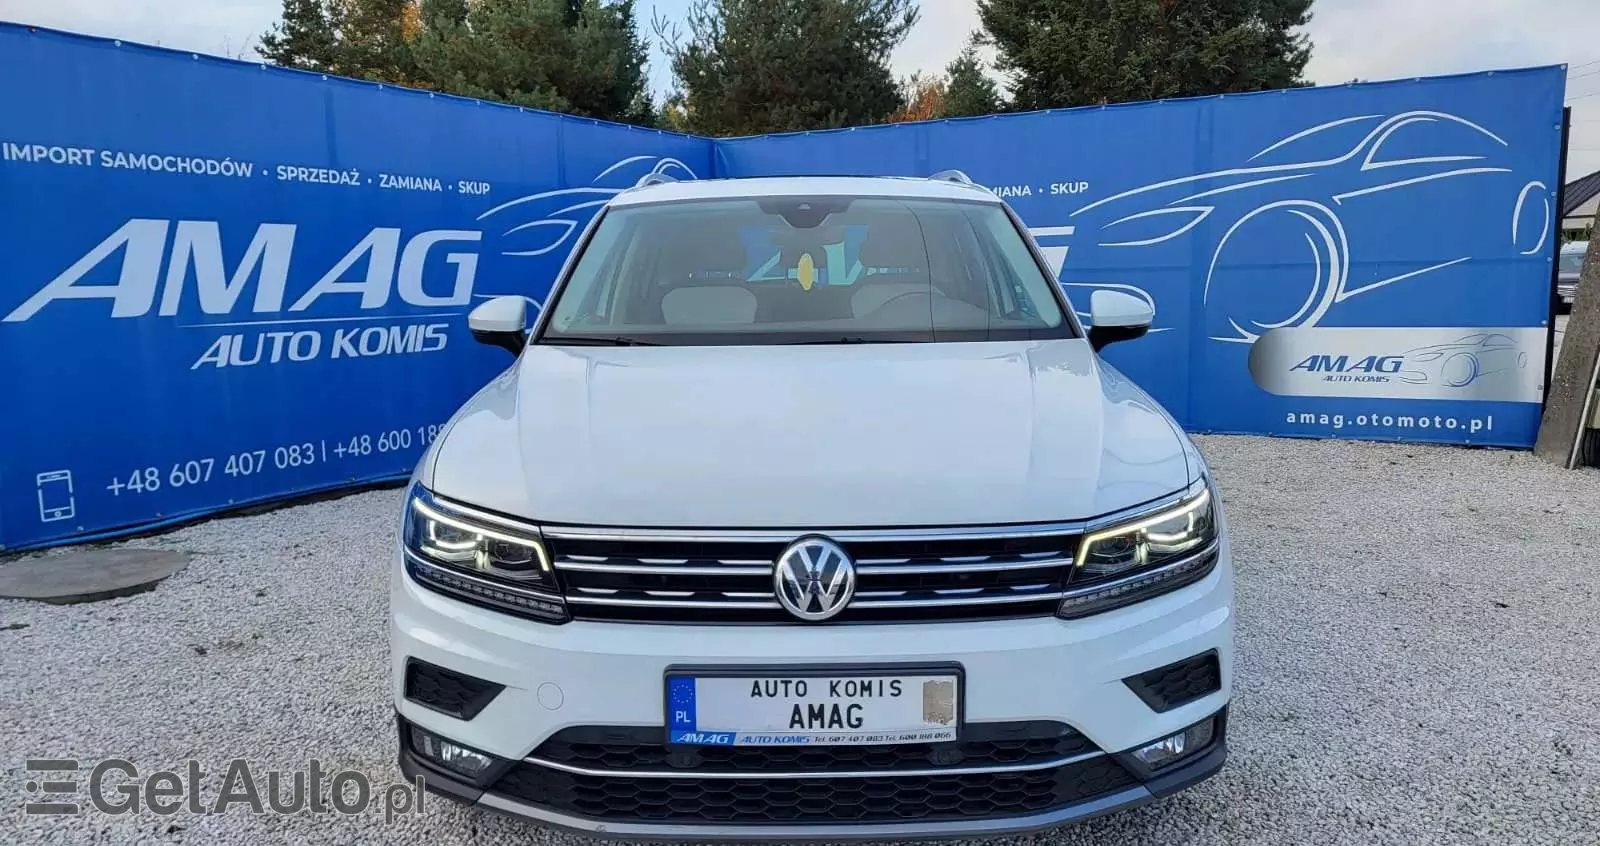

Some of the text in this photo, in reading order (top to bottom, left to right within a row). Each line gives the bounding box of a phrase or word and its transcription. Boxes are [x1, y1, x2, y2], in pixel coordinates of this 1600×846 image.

[2, 142, 491, 196] IMPORT SAMOCHODÓW SPRZEDAŻ ZAMIANA SKUP
[1050, 181, 1089, 195] SKUP
[190, 323, 449, 370] AUTO KOMIS
[1286, 412, 1493, 433] amag.otomoto.pl
[106, 467, 161, 496] +48
[169, 458, 215, 487] 607
[224, 450, 267, 478] 407
[274, 443, 316, 470] 083
[333, 434, 372, 459] +48
[377, 428, 412, 453] 600
[750, 679, 903, 698] AUTO KOMIS
[675, 710, 691, 723] PL
[788, 703, 864, 730] AMAG
